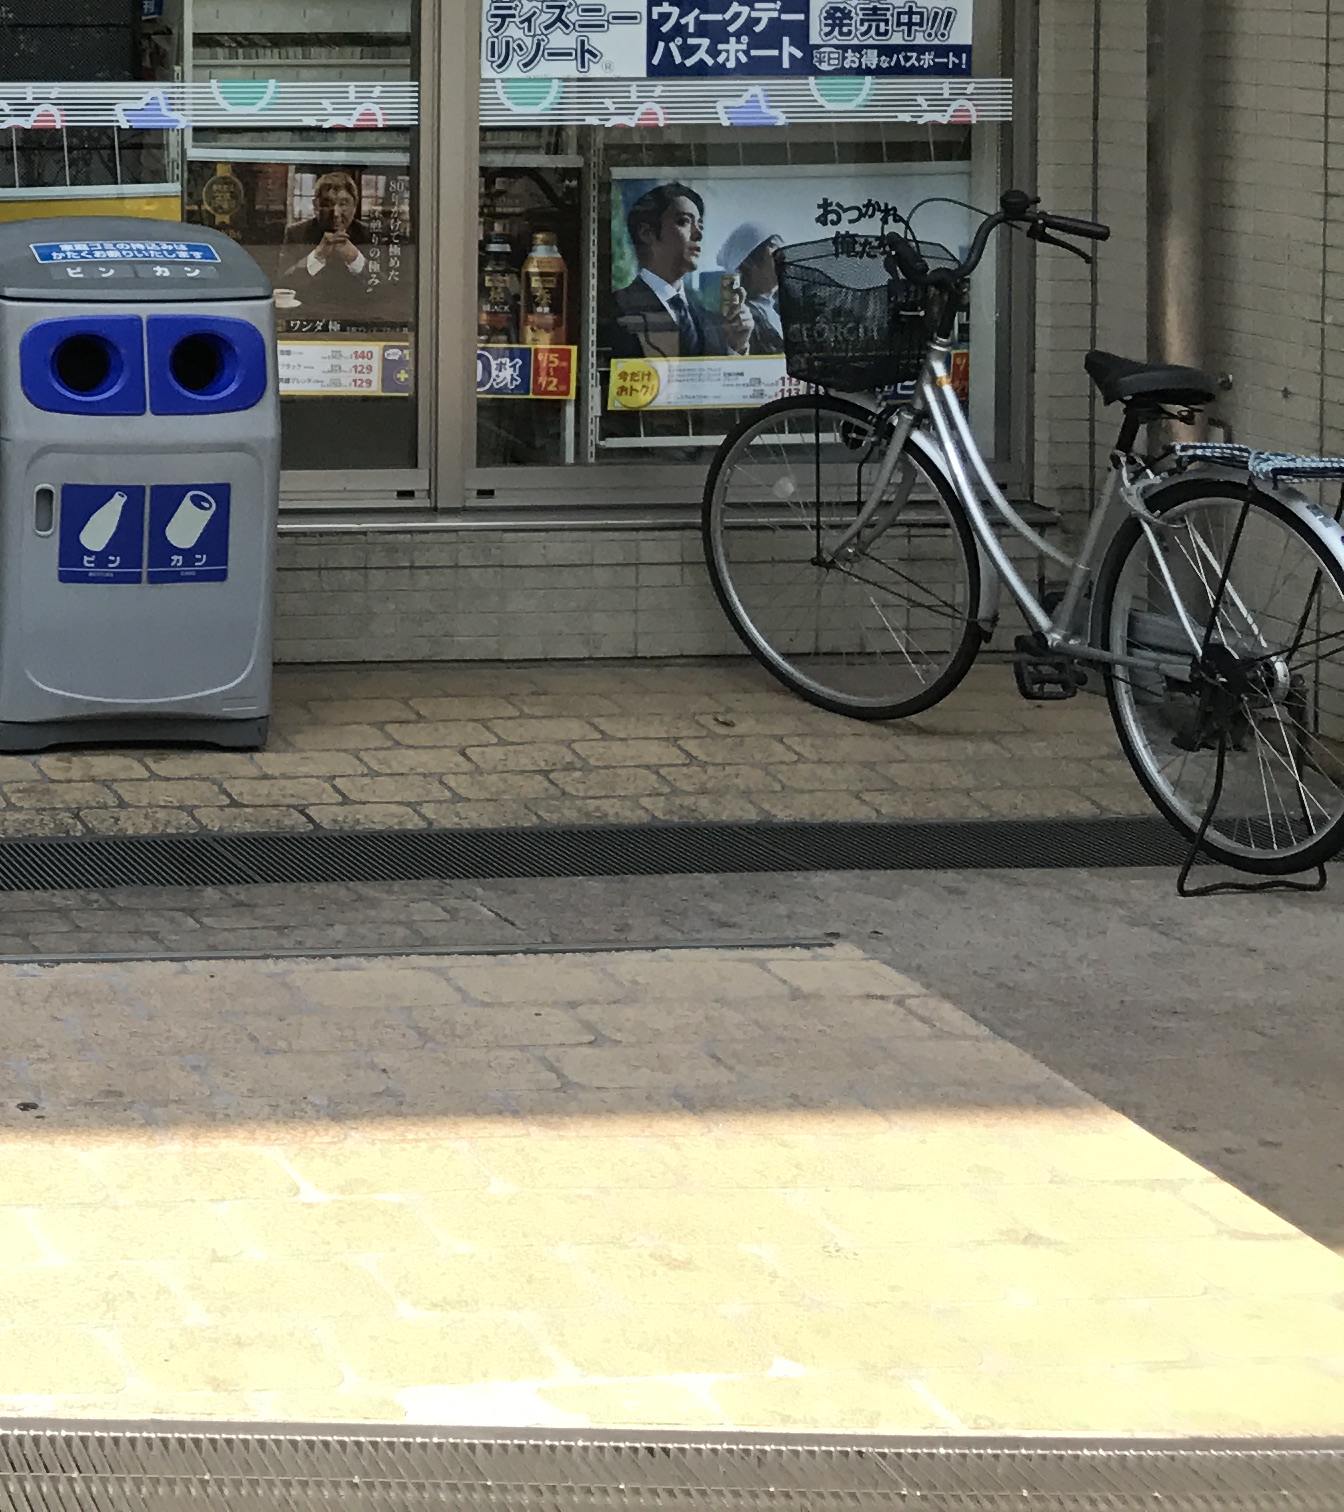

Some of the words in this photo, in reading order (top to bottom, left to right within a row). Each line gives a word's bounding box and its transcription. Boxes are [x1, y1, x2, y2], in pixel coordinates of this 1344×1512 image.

[488, 1, 640, 37] ディズニー
[652, 2, 805, 35] ウィークデー
[487, 35, 602, 74] リゾート
[652, 36, 804, 70] パスポート
[815, 197, 902, 227] おつかれ
[59, 244, 188, 252] 家庭ゴミの持込みは
[831, 231, 891, 260] 俺た
[50, 251, 204, 260] かたくお断りいたします
[66, 266, 116, 278] ビン
[152, 265, 201, 278] カン
[290, 319, 325, 333] ワンダ
[353, 350, 374, 361] 140
[352, 364, 373, 374] 129
[617, 371, 652, 381] 今だけ
[352, 378, 373, 388] 129
[83, 554, 121, 568] ビン
[170, 554, 207, 567] カン
